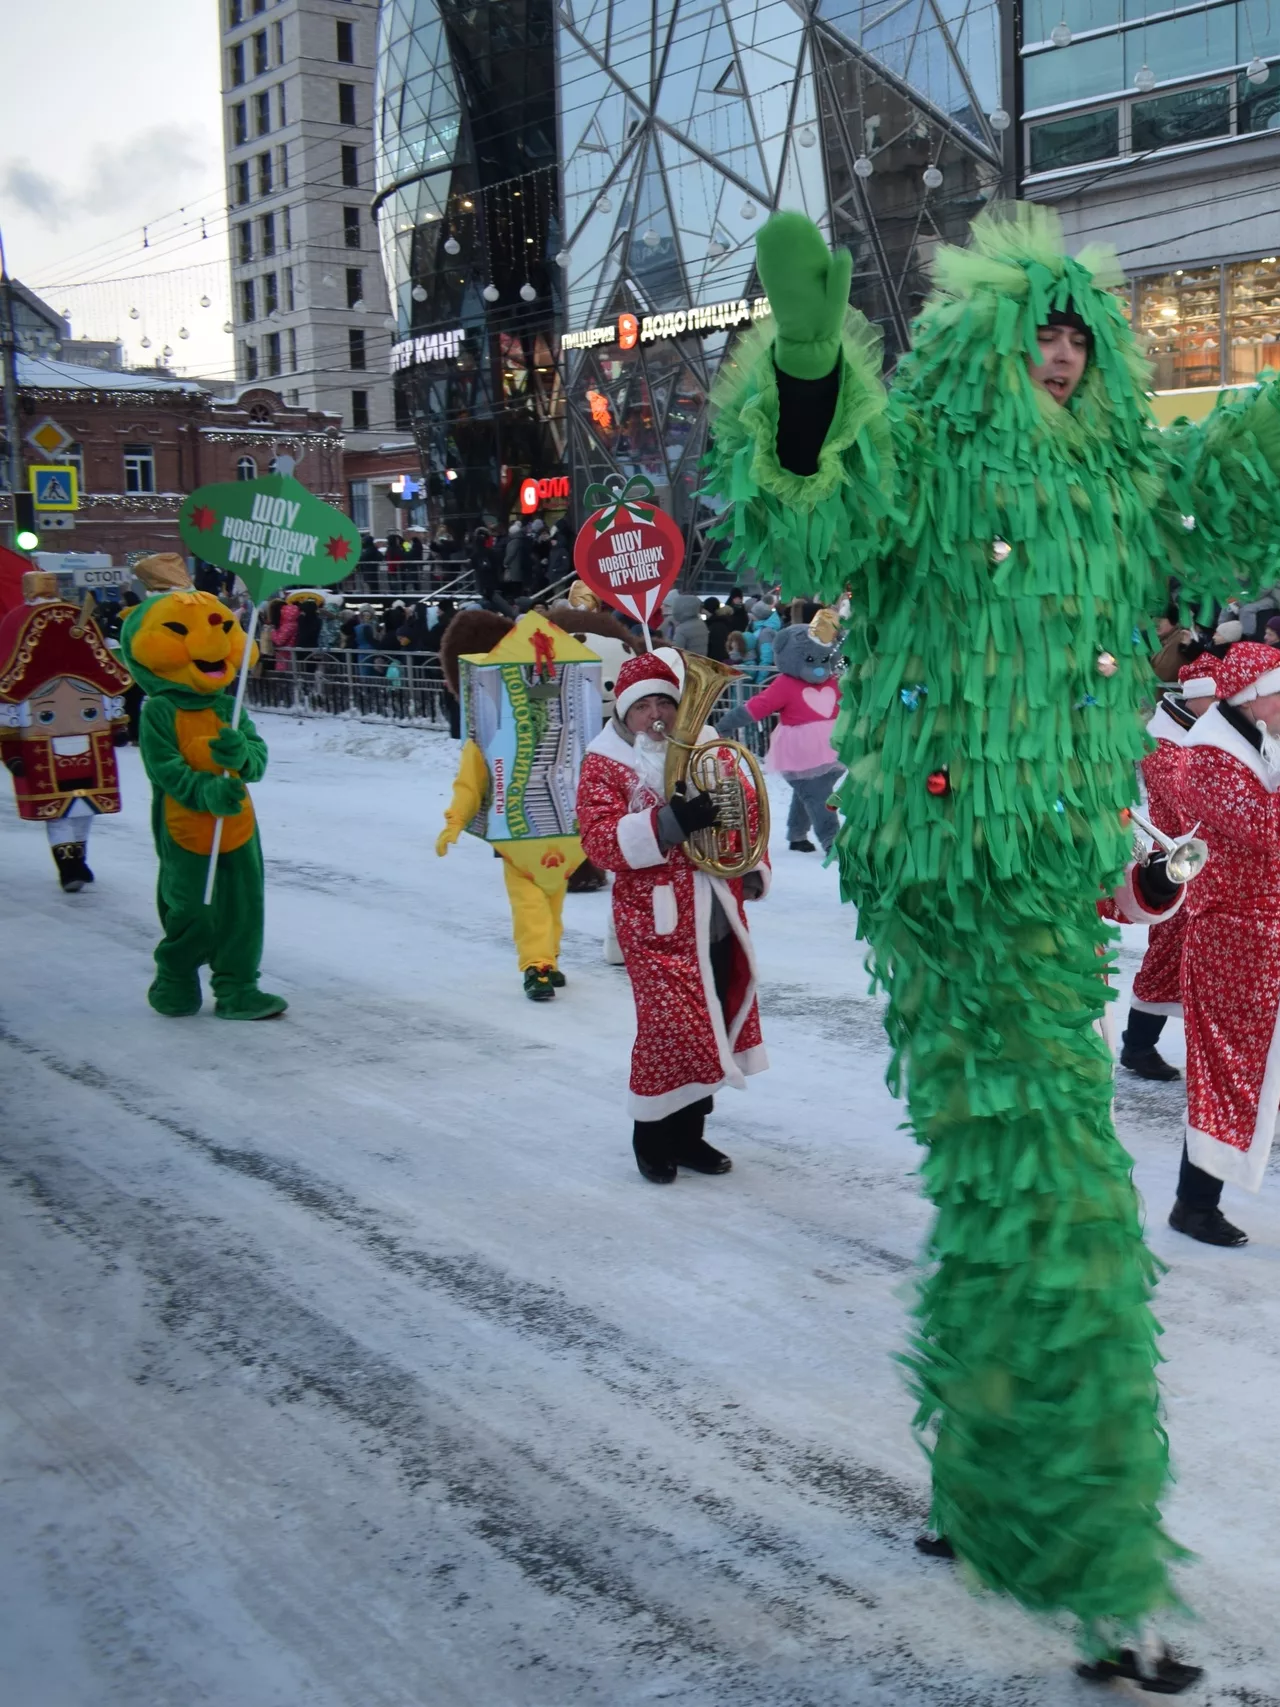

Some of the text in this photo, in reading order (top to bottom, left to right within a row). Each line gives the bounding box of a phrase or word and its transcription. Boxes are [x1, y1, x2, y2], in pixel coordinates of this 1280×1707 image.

[561, 326, 615, 349] ПИЦЦЕРИЯ
[687, 299, 749, 331] ПИЦЦА
[415, 329, 466, 364] КИНГ
[251, 493, 301, 529] ШОУ
[222, 516, 318, 556] НОВОГОДНИХ
[610, 529, 642, 555] ШОУ
[228, 540, 303, 576] ИГРУШЕК
[598, 546, 664, 573] НОВОГОДНИХ
[609, 562, 660, 587] ИГРУШЕК
[84, 571, 122, 583] СТОП
[503, 664, 533, 838] НОВОСИБИРСКИЕ
[495, 758, 504, 814] КОНФЕТЫ
